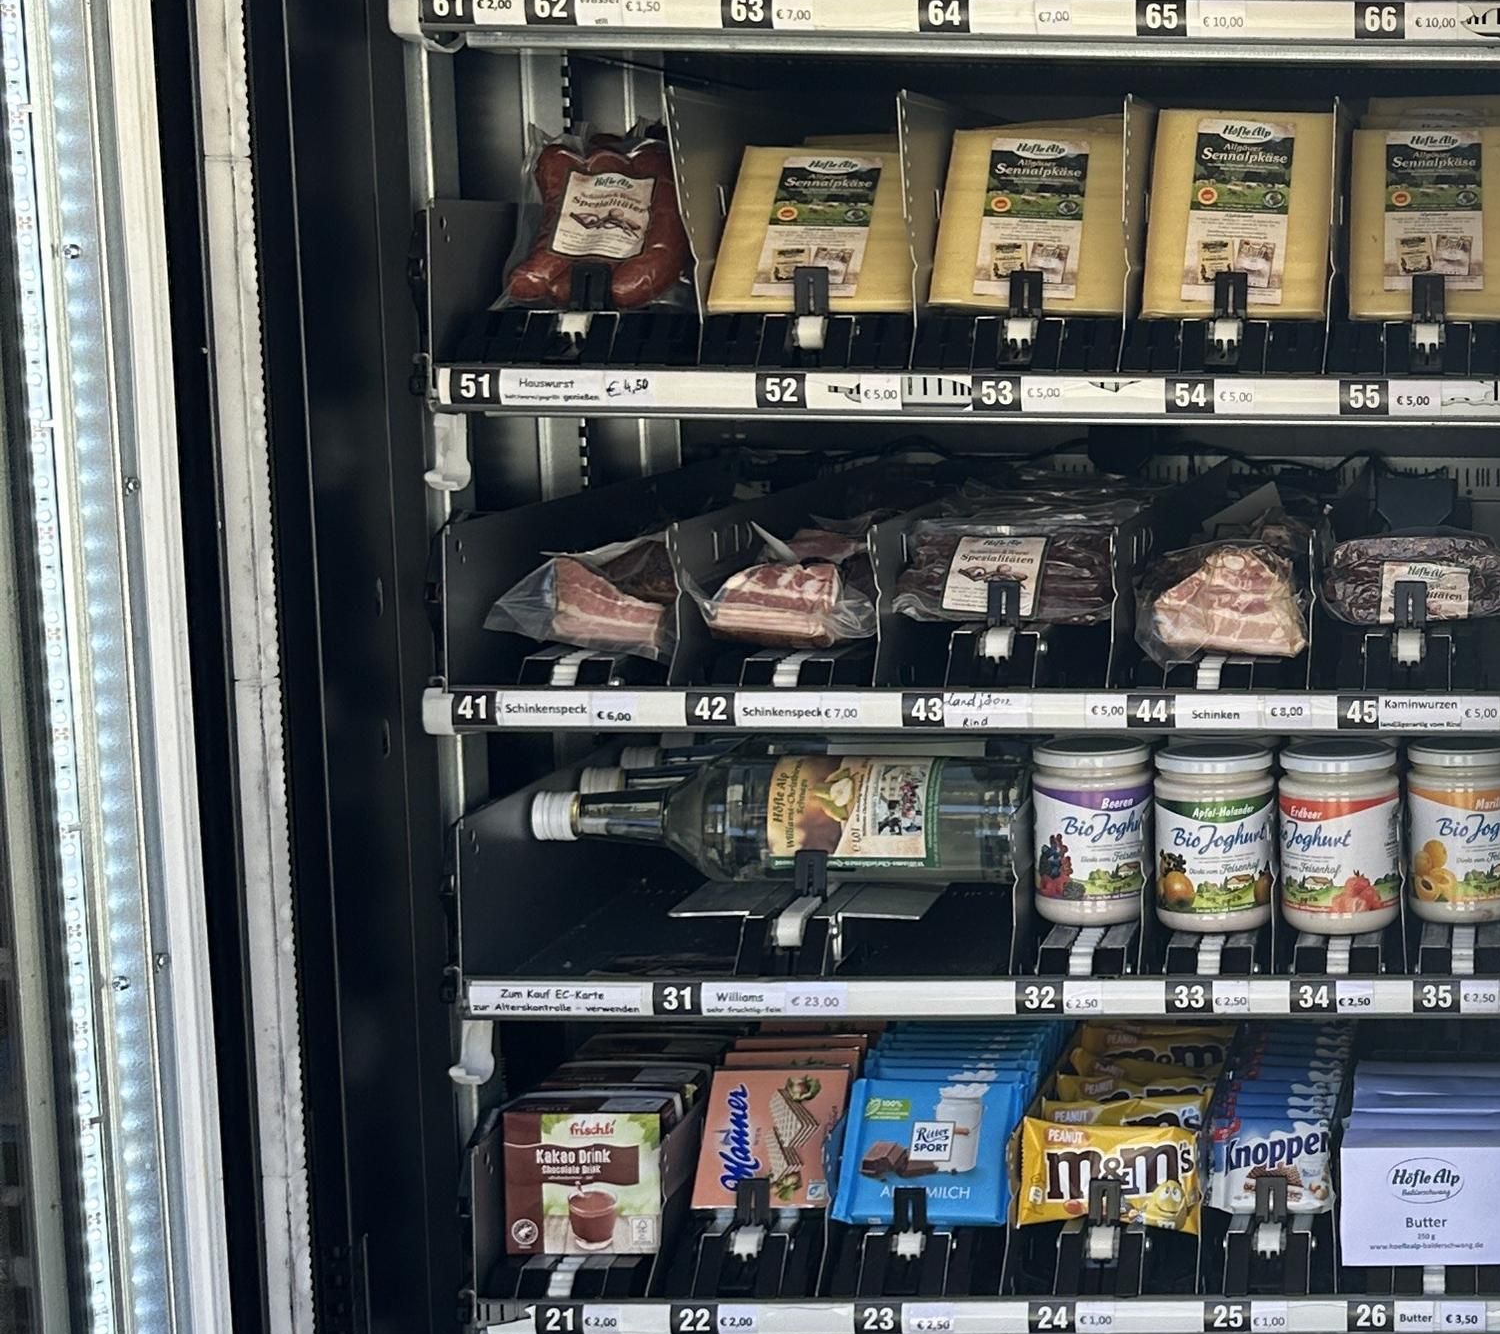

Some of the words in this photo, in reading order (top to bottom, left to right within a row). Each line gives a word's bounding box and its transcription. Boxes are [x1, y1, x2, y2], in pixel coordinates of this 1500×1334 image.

[477, 0, 484, 9] €
[487, 0, 512, 11] 2,00
[626, 2, 633, 12] €
[636, 1, 661, 14] 1,50
[928, 0, 961, 26] 64
[1146, 3, 1178, 29] 65
[1365, 6, 1397, 32] 66
[1415, 18, 1422, 27] €
[1423, 17, 1455, 29] 10,00
[1202, 147, 1288, 165] Sennalpkäse
[460, 373, 492, 399] 51
[519, 378, 574, 388] Hauswurst
[606, 381, 620, 397] €
[623, 379, 649, 393] 4,50
[765, 378, 797, 402] 52
[981, 381, 1013, 405] 53
[1175, 382, 1207, 407] 54
[1350, 385, 1380, 409] 55
[1397, 396, 1404, 406] €
[1406, 395, 1430, 407] 5,00
[457, 695, 487, 719] 41
[505, 703, 587, 715] Schinkenspeck
[694, 696, 727, 720] 42
[742, 707, 822, 718] Schinkenspeck
[825, 708, 832, 718] €
[834, 708, 858, 719] 7,00
[911, 698, 943, 721] 43
[1136, 699, 1167, 721] 44
[1192, 709, 1240, 720] Schinken
[1346, 700, 1377, 722] 45
[1384, 700, 1457, 710] Kaminwurzen
[597, 711, 604, 720] €
[607, 711, 631, 722] 6,00
[1102, 797, 1133, 810] Beeren
[1290, 805, 1323, 819] Erdbeer
[1061, 817, 1093, 836] Bio
[1171, 827, 1200, 848] Bio
[1199, 822, 1266, 853] Joghurt
[1286, 820, 1352, 851] Joghurt
[500, 989, 523, 999] Zum
[527, 989, 550, 1000] Kauf
[555, 990, 604, 1000] EC-Karte
[663, 986, 692, 1010] 31
[716, 992, 764, 1002] Williams
[791, 997, 799, 1006] €
[804, 996, 839, 1008] 23,00
[1024, 986, 1055, 1009] 32
[1174, 985, 1205, 1008] 33
[1299, 985, 1329, 1007] 34
[1422, 985, 1452, 1007] 35
[569, 1119, 615, 1136] frischli
[1048, 1129, 1085, 1145] PEANUT
[536, 1149, 575, 1165] Kakao
[579, 1146, 611, 1165] Drink
[913, 1143, 948, 1152] SPORT
[1392, 1169, 1431, 1187] Höfle
[1433, 1169, 1460, 1186] Alp
[1406, 1217, 1447, 1228] Butter
[545, 1308, 574, 1331] 21
[679, 1309, 710, 1331] 22
[863, 1308, 894, 1330] 23
[1037, 1306, 1068, 1329] 24
[1213, 1305, 1243, 1327] 25
[1356, 1304, 1387, 1326] 26
[1399, 1314, 1432, 1323] Butter
[1446, 1315, 1453, 1324] €
[1455, 1314, 1478, 1325] 3,50
